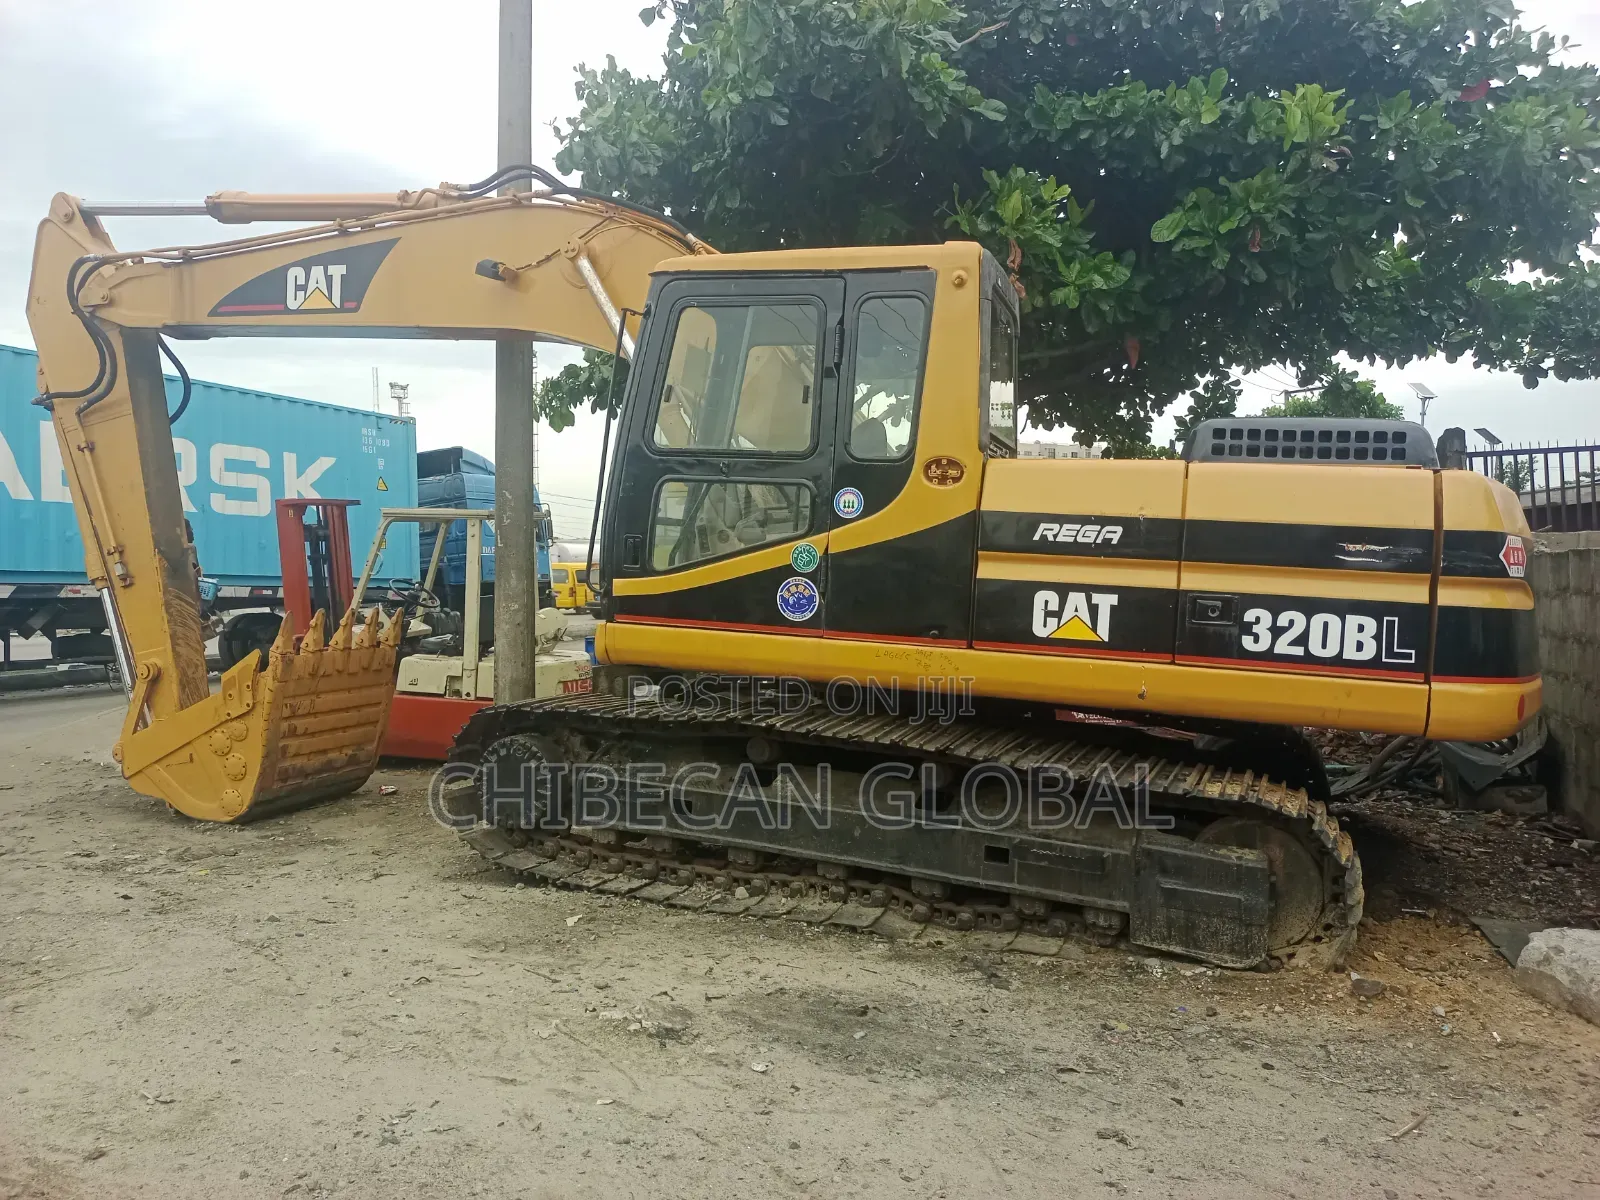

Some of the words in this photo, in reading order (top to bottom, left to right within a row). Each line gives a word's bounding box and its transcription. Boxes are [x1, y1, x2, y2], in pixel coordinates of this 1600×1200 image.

[286, 264, 347, 310] CAT
[1032, 523, 1124, 545] REGA
[1032, 590, 1119, 642] CAT
